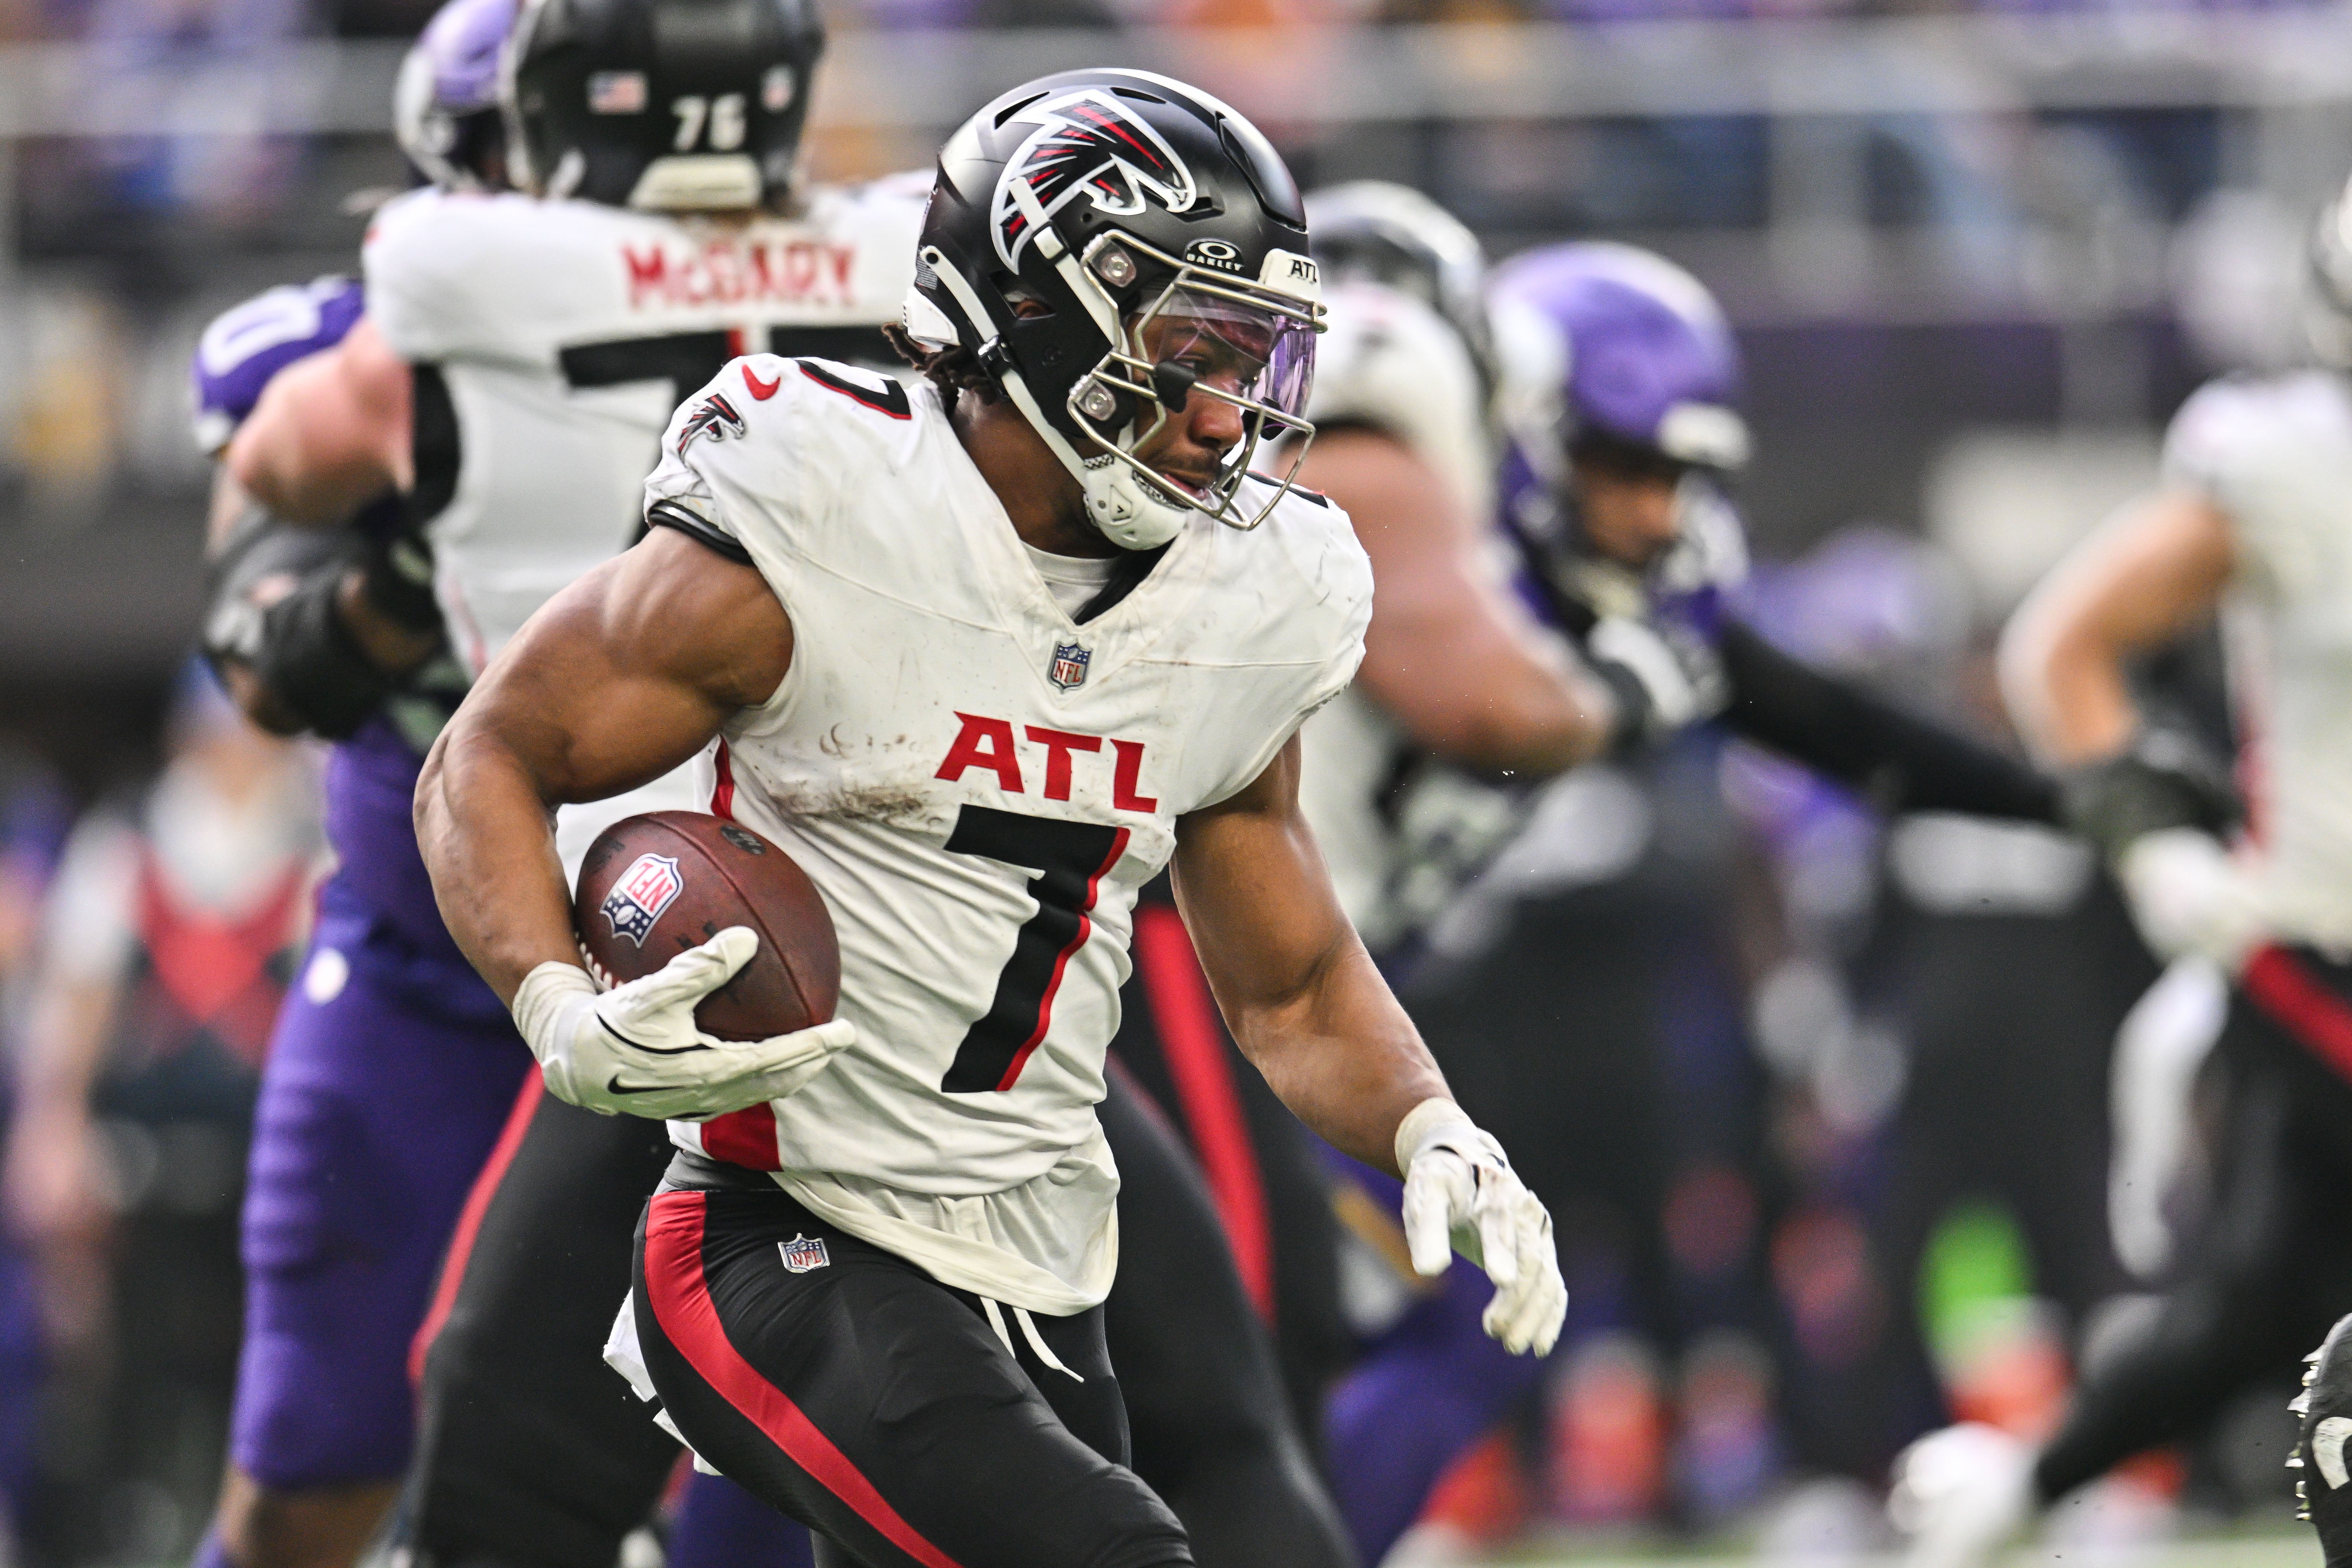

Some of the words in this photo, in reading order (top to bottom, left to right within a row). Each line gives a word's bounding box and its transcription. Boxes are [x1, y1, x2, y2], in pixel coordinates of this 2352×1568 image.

[672, 93, 745, 150] 76
[1186, 253, 1244, 271] OAKLEY
[1288, 259, 1317, 284] ATL
[1054, 660, 1081, 683] NFL
[934, 711, 1157, 813] ATL
[626, 862, 673, 912] NFL
[941, 803, 1131, 1093] 7
[791, 1250, 822, 1267] NFL
